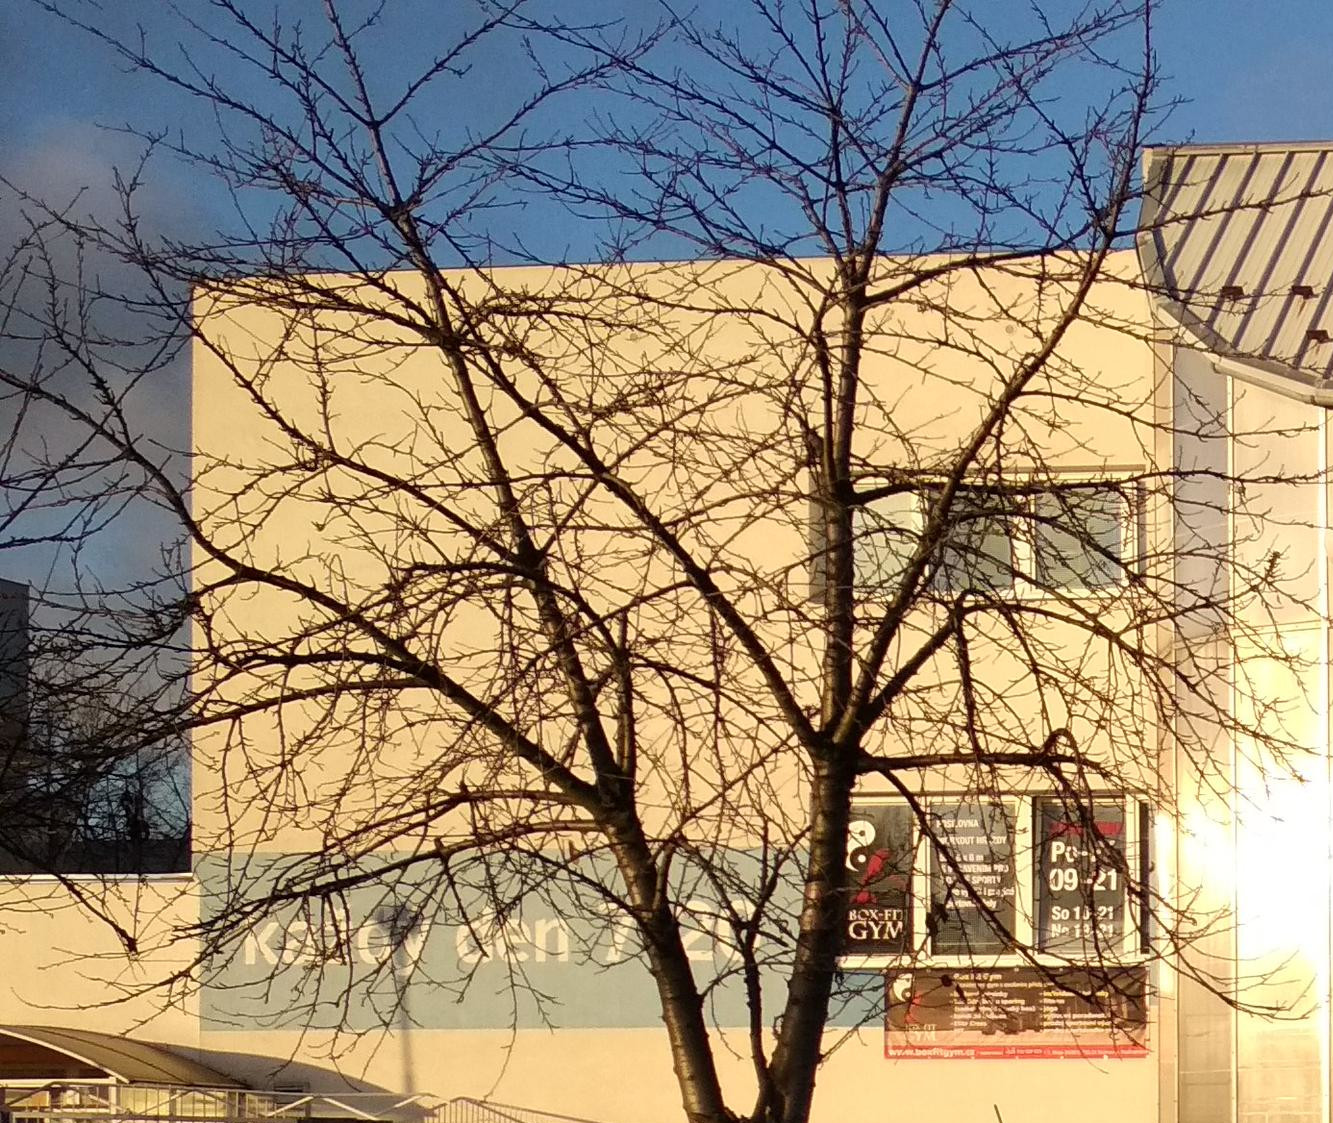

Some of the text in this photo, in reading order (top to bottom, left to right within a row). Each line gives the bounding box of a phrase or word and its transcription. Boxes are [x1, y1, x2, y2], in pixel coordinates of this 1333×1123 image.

[1051, 906, 1070, 920] So
[457, 906, 568, 964] den
[848, 921, 904, 940] GYM
